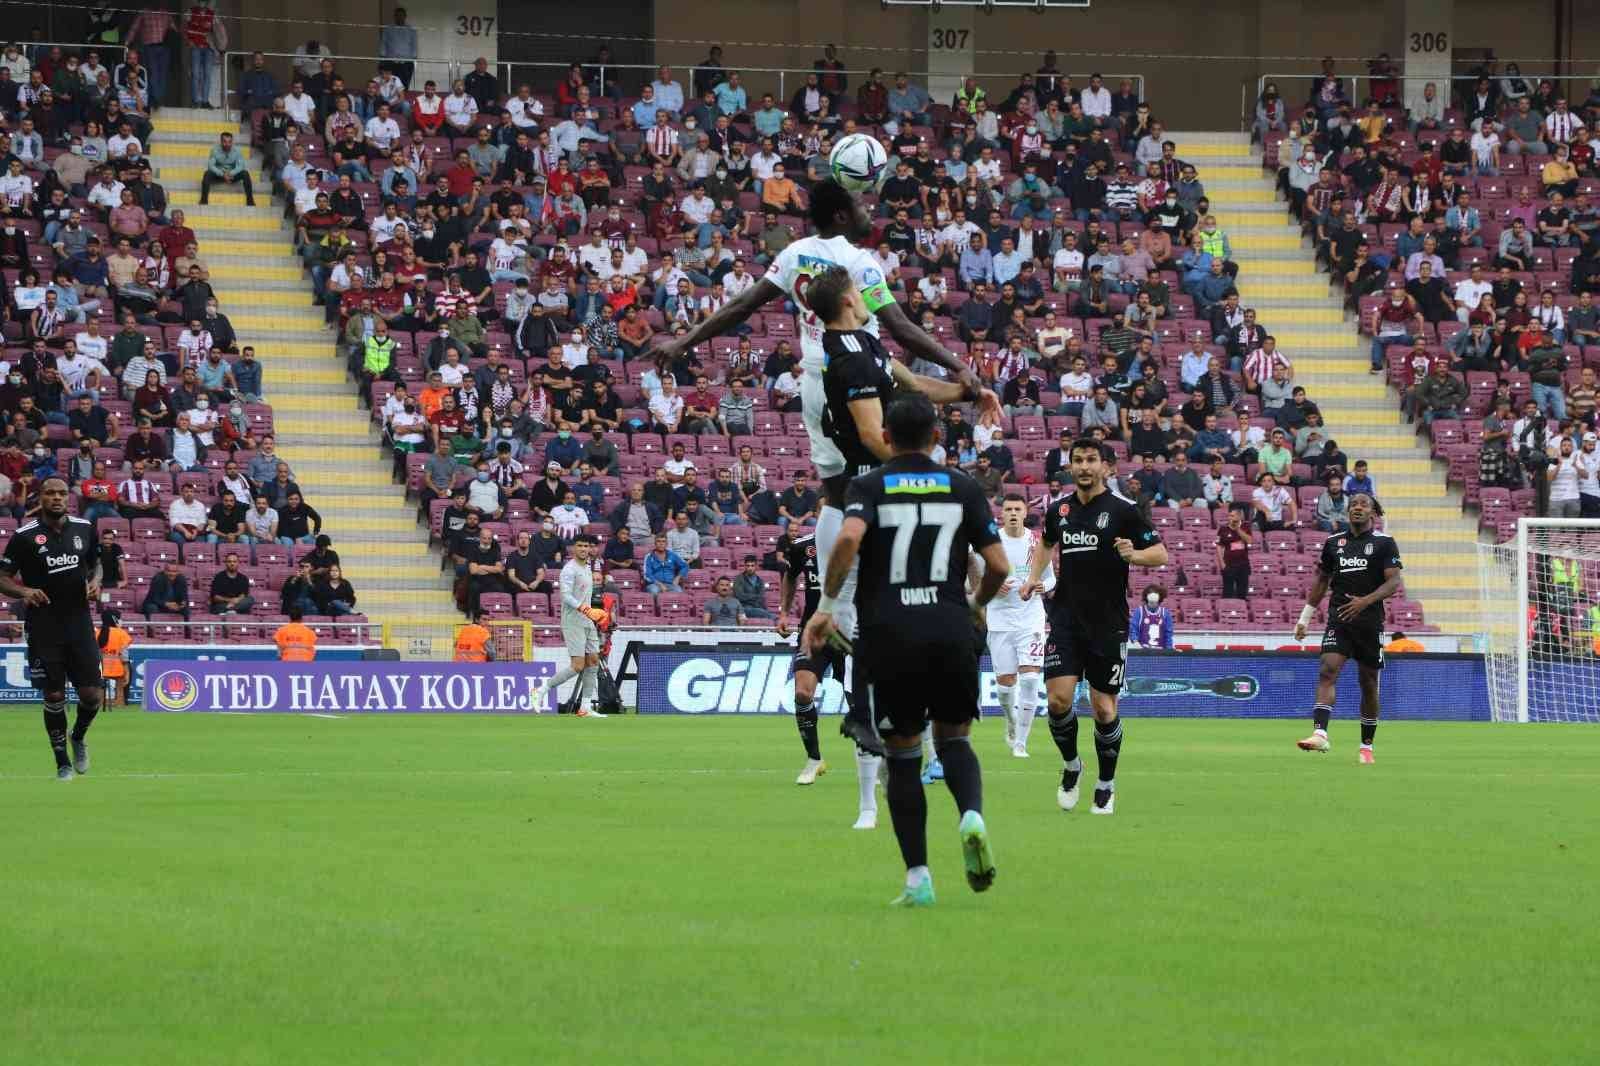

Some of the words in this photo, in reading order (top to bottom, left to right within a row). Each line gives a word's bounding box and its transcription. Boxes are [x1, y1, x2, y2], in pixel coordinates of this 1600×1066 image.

[457, 16, 495, 37] 307
[934, 28, 969, 49] 307
[1410, 32, 1447, 53] 306
[877, 502, 964, 584] 77
[1062, 530, 1099, 546] beko
[46, 553, 79, 567] beko
[1339, 556, 1368, 567] beko
[900, 586, 938, 605] UMUT
[204, 674, 279, 709] TED
[288, 674, 411, 710] HATAY
